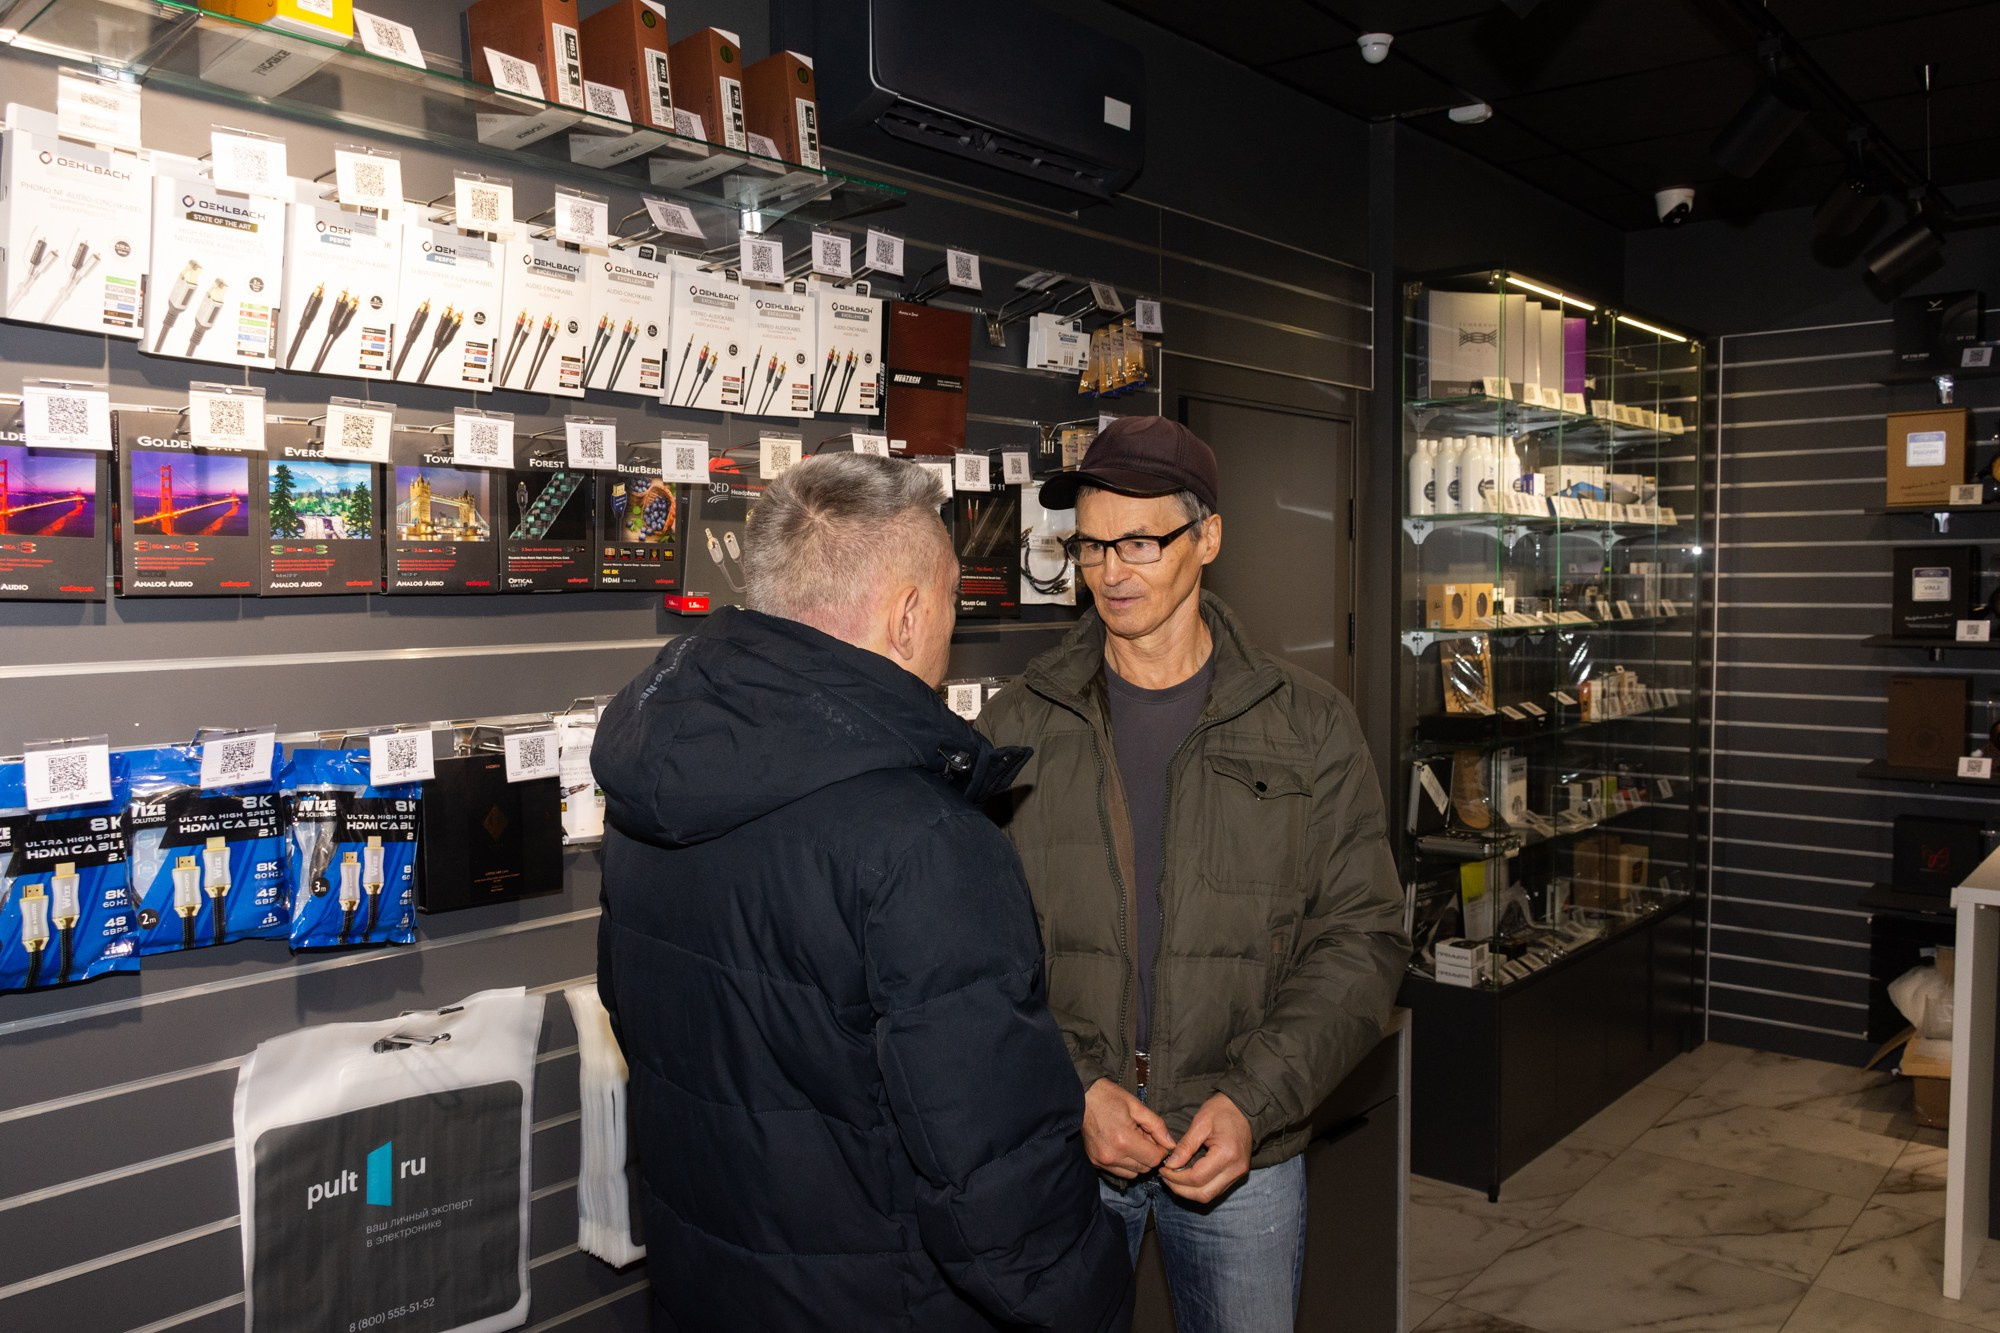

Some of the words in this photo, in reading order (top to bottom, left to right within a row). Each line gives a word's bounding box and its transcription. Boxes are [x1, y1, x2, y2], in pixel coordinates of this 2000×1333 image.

[57, 157, 131, 181] OEHLBACH
[198, 200, 267, 221] OEHLBACH
[193, 213, 212, 223] STATE
[214, 217, 224, 225] OF
[225, 219, 238, 228] THE
[239, 222, 253, 231] ART
[533, 258, 581, 274] OEHLBACH
[615, 265, 659, 280] OEHLBACH
[699, 288, 740, 302] OEHLBACH
[765, 302, 804, 313] OEHLBACH
[839, 304, 873, 315] OEHLBACH
[529, 458, 565, 469] FOREST
[708, 481, 730, 494] QED
[997, 483, 1006, 492] 11
[134, 579, 168, 588] ANALOG
[168, 579, 194, 588] AUDIO
[270, 581, 300, 589] ANALOG
[508, 576, 534, 585] OPTICAL
[602, 576, 620, 584] HDMI
[242, 795, 273, 810] 8K
[178, 814, 216, 824] ULTRA
[218, 811, 244, 820] HIGH
[247, 808, 276, 817] SPEED
[90, 817, 123, 833] 8K
[179, 821, 220, 835] HDMI
[222, 816, 277, 831] CABLE
[346, 822, 379, 831] HDMI
[258, 827, 279, 838] 2.1
[25, 838, 64, 849] ULTRA
[66, 835, 94, 846] HIGH
[26, 846, 70, 862] HDMI
[71, 839, 126, 856] CABLE
[256, 861, 278, 873] 8K
[105, 889, 127, 901] 8K
[256, 887, 278, 898] 48
[104, 915, 128, 928] 48
[102, 925, 130, 938] GBPS
[307, 1168, 359, 1211] pult
[400, 1156, 427, 1180] ru
[365, 1222, 388, 1235] ваш
[389, 1208, 430, 1231] личный
[431, 1198, 475, 1217] эксперт
[366, 1239, 374, 1249] в
[375, 1218, 443, 1246] электронике
[349, 1322, 357, 1333] 8
[357, 1312, 386, 1332] (800)
[387, 1296, 435, 1320] 555-51-52
